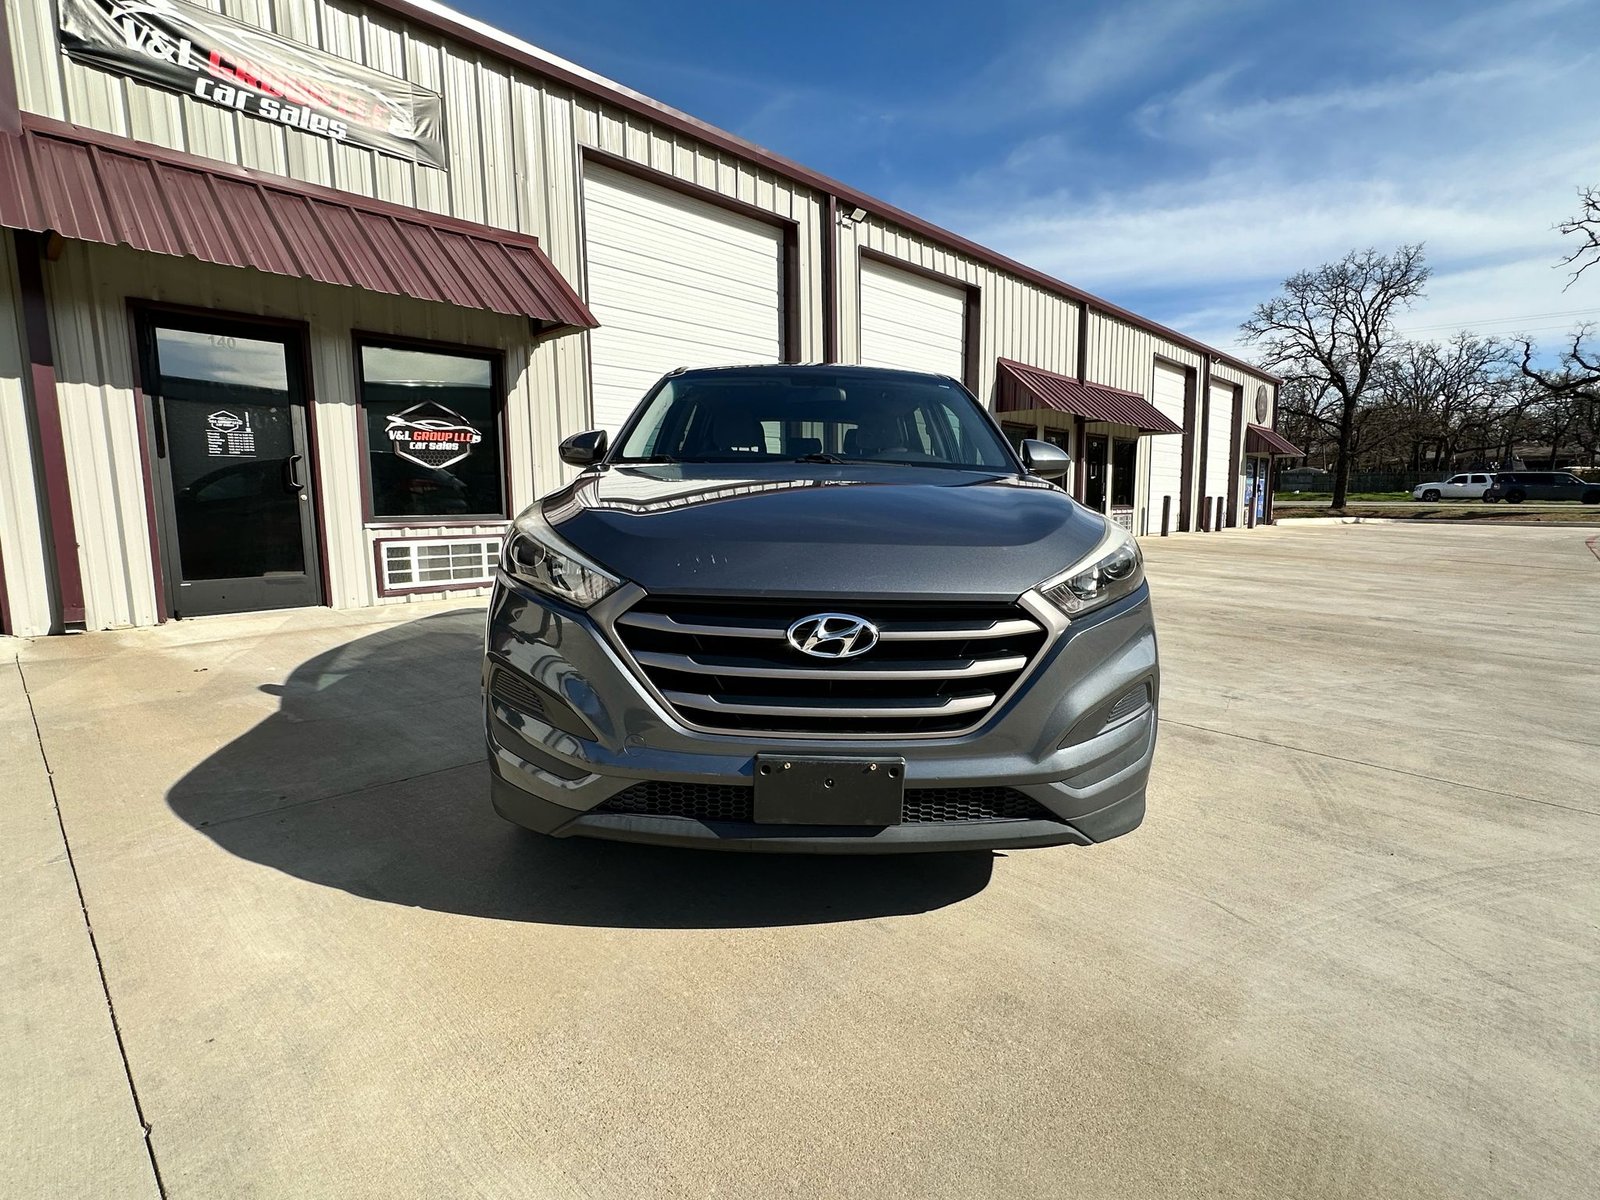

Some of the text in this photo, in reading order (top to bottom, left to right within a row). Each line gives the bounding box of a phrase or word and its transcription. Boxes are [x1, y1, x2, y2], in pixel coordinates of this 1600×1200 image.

[122, 17, 199, 72] V&L
[194, 76, 349, 140] car sales
[207, 335, 237, 350] 140
[388, 430, 473, 442] V&L GROUP LLC
[409, 441, 459, 450] car sales
